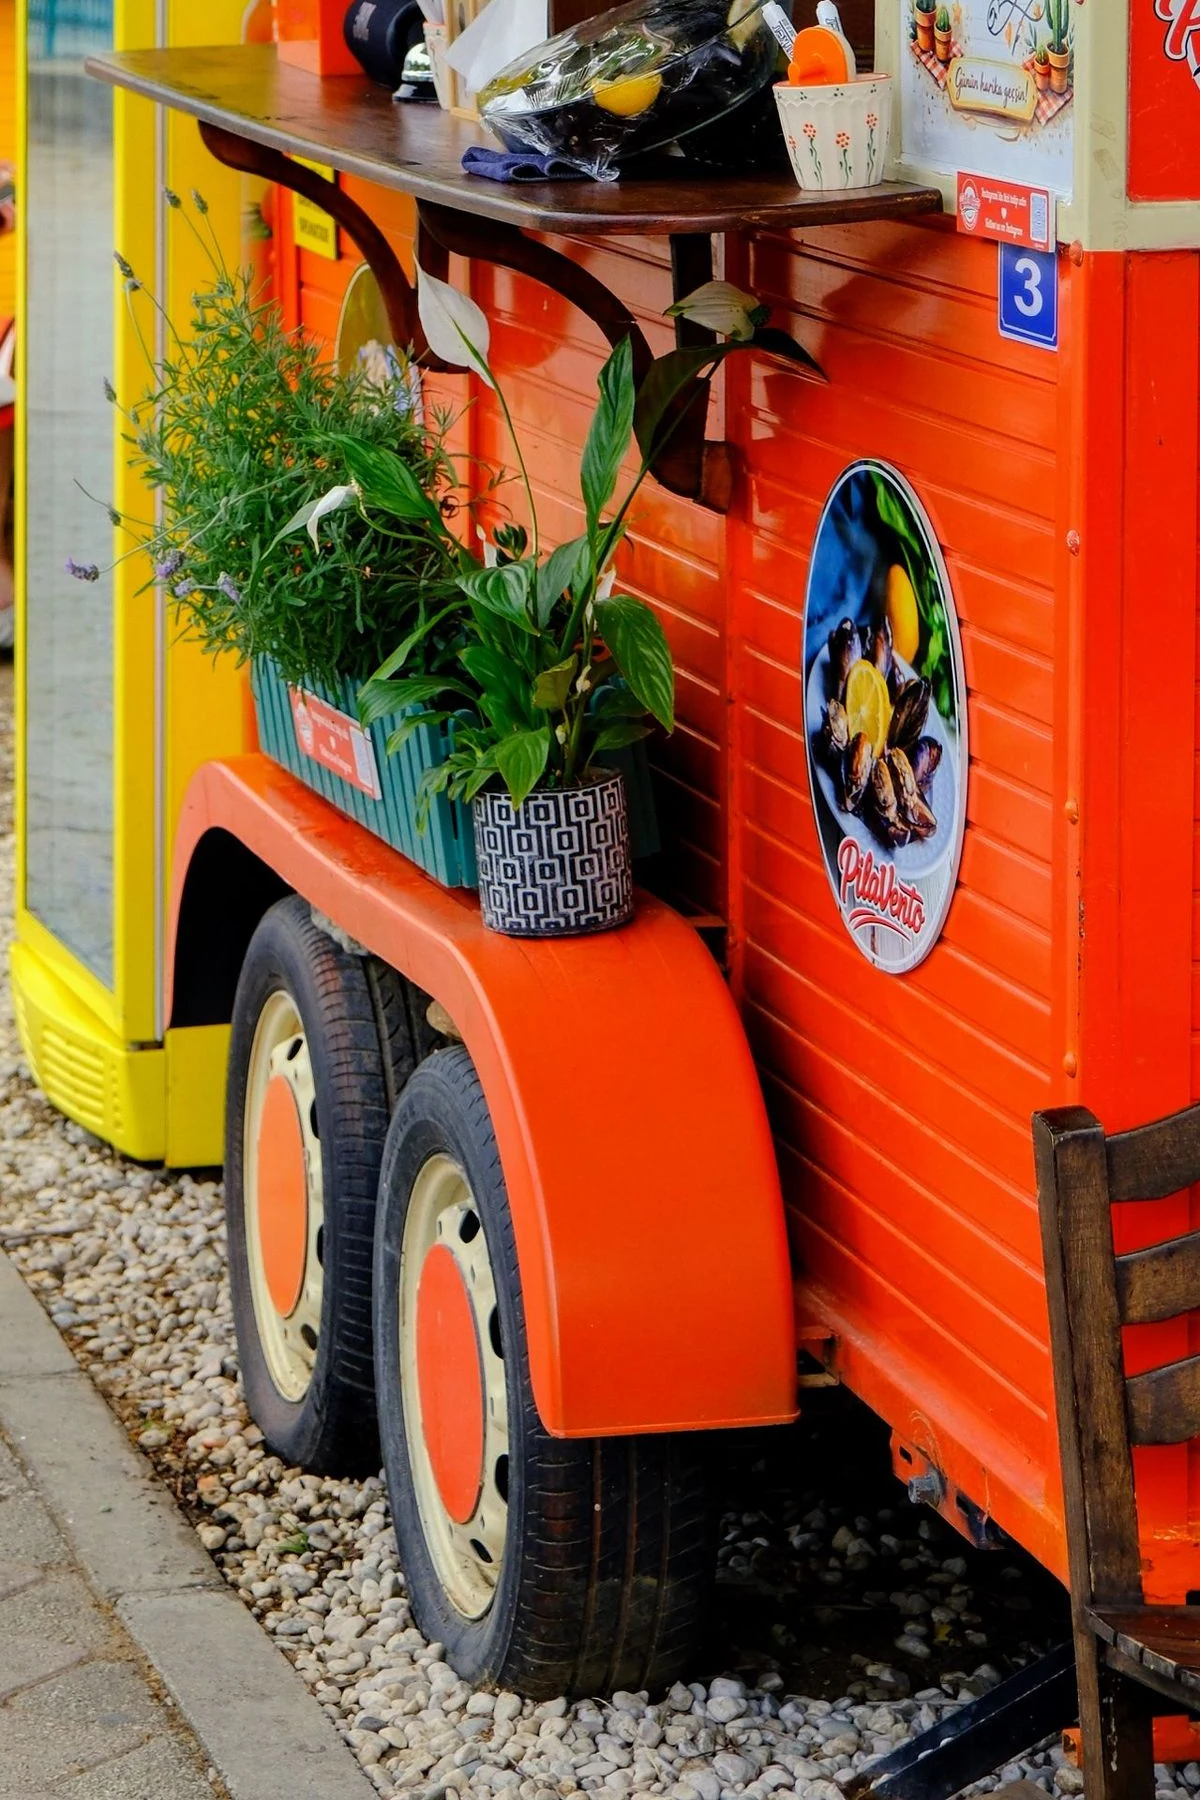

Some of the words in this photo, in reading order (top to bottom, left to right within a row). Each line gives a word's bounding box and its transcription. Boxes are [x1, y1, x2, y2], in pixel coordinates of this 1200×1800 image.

[955, 66, 978, 100] Günün
[1013, 257, 1044, 317] 3
[837, 835, 926, 934] PilaVento
